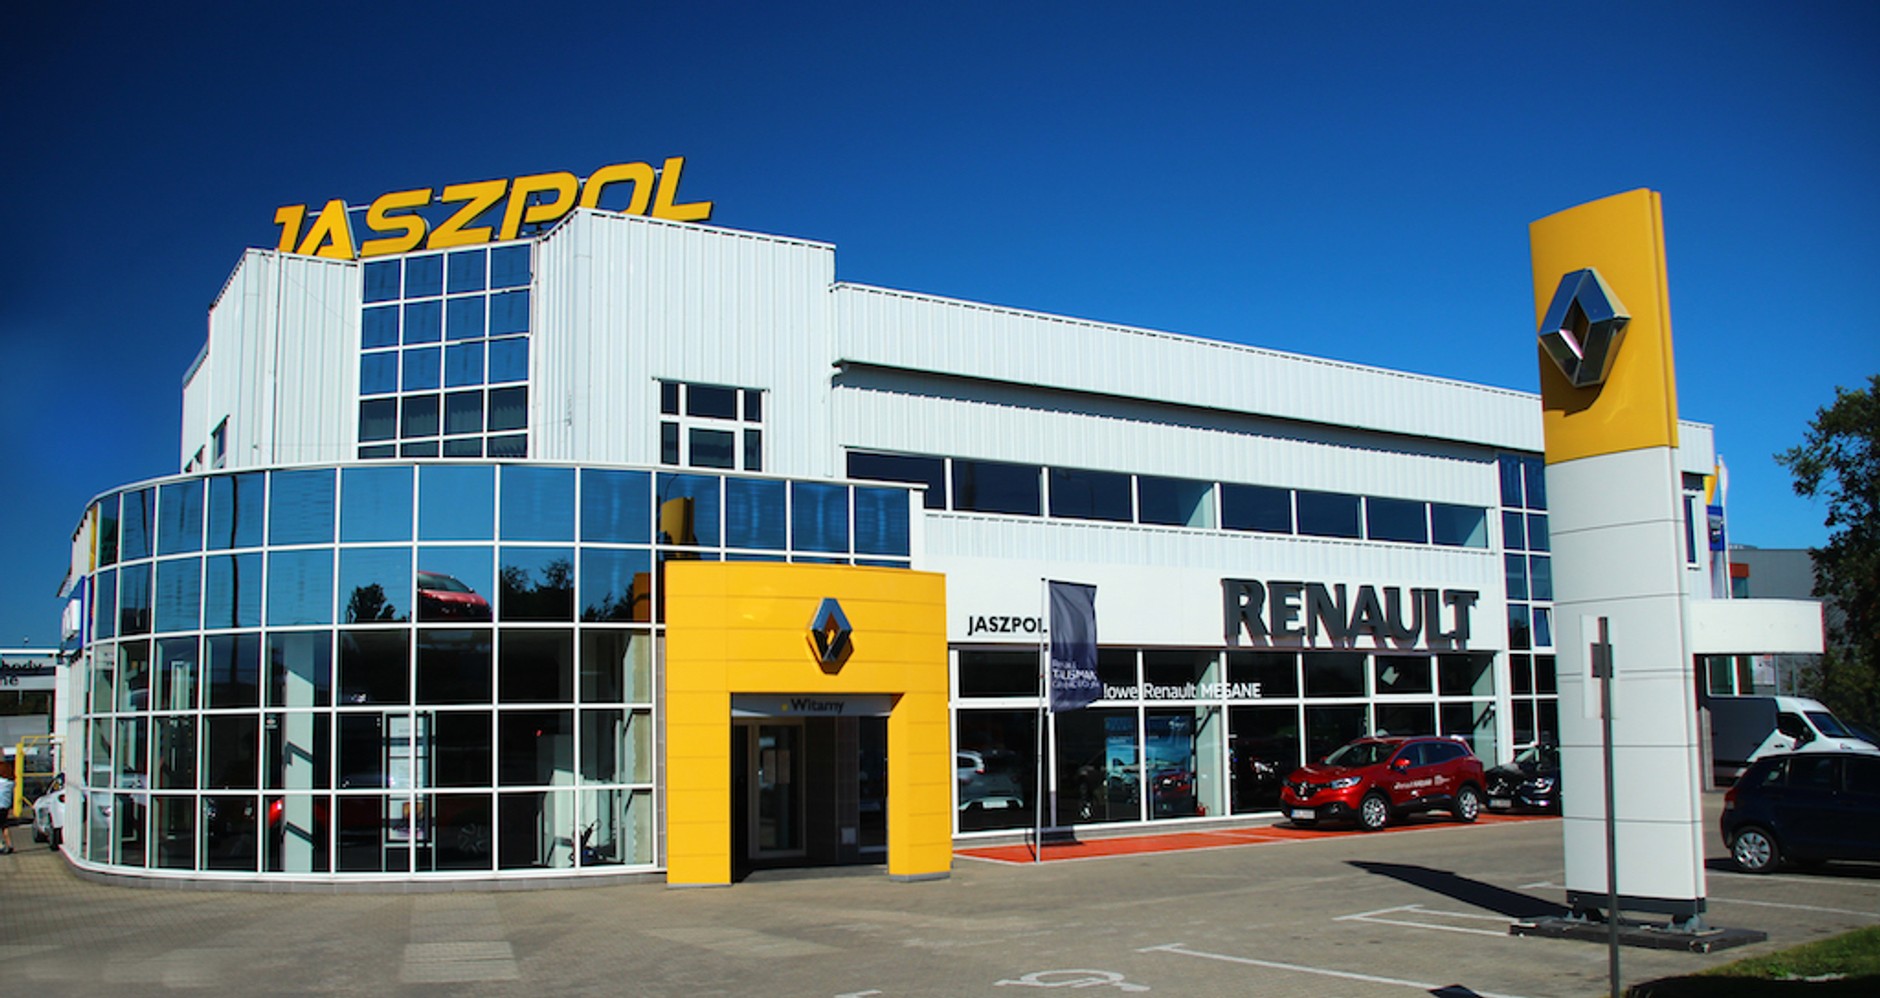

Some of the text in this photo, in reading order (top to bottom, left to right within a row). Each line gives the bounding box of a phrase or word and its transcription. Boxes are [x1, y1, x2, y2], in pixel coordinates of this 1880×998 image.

[273, 156, 715, 260] JASZPOL
[1221, 578, 1480, 648] RENAULT
[967, 615, 1048, 636] JASZPOL
[1103, 682, 1138, 699] owe
[1143, 682, 1197, 699] Renault
[790, 698, 845, 714] Witamy
